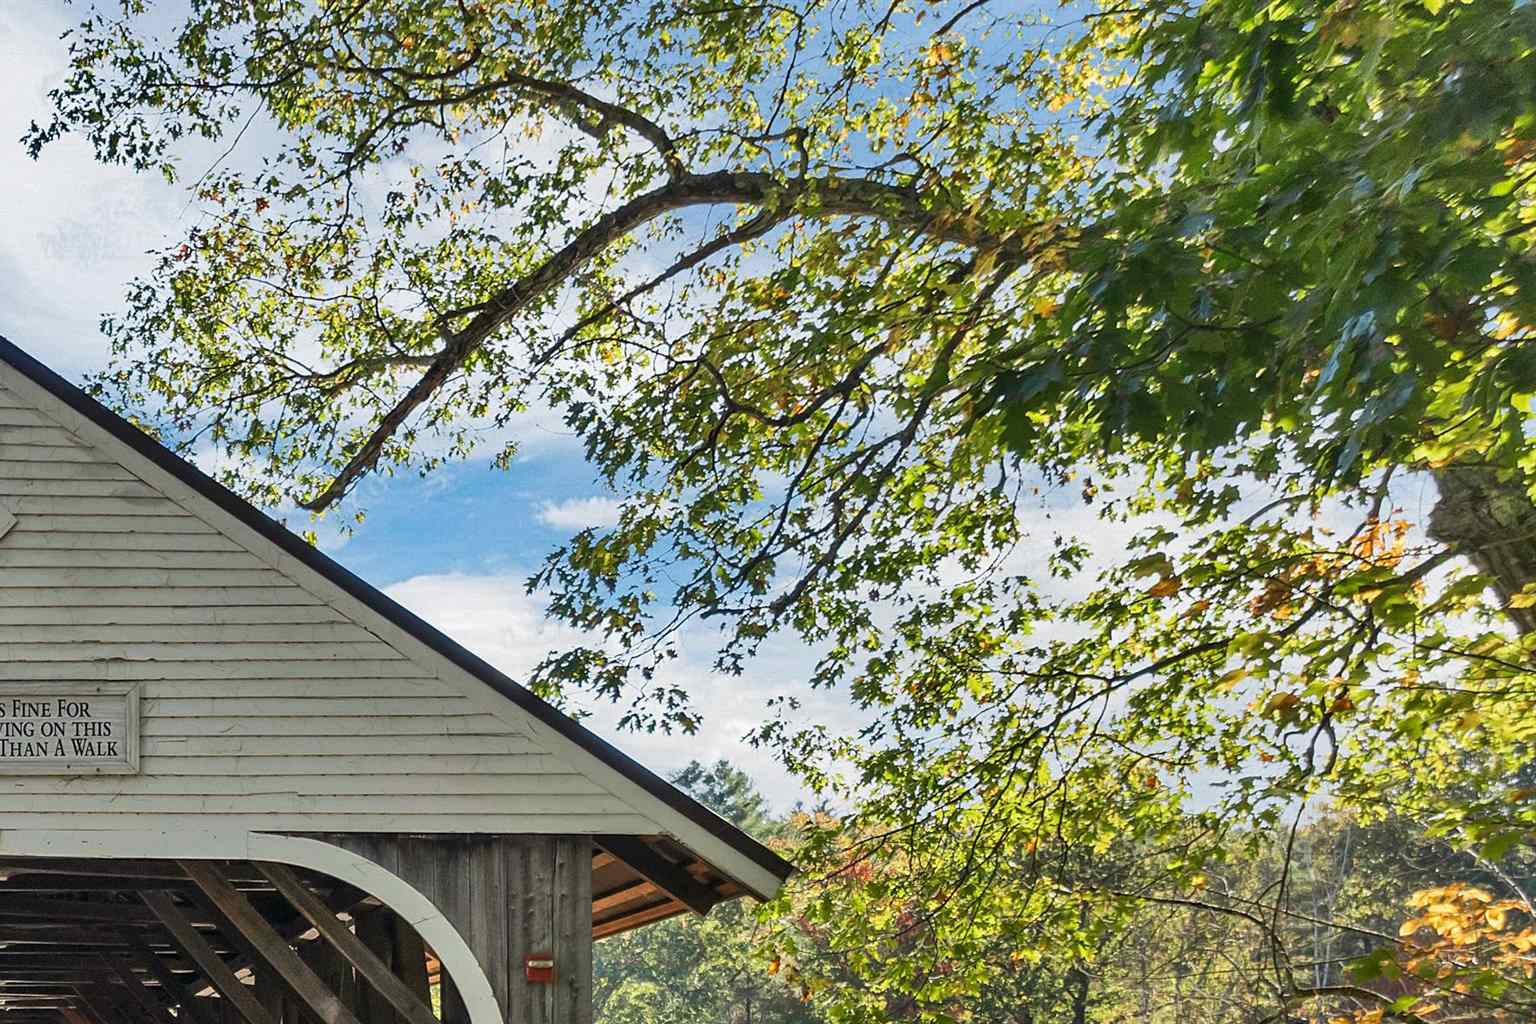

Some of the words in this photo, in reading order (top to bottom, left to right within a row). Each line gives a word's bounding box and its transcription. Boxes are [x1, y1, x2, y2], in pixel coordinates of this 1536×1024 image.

[12, 698, 52, 718] FINE
[57, 698, 92, 718] FOR
[40, 721, 67, 738] ON
[71, 720, 112, 737] THIS
[54, 738, 66, 757] A
[70, 737, 119, 757] WALK
